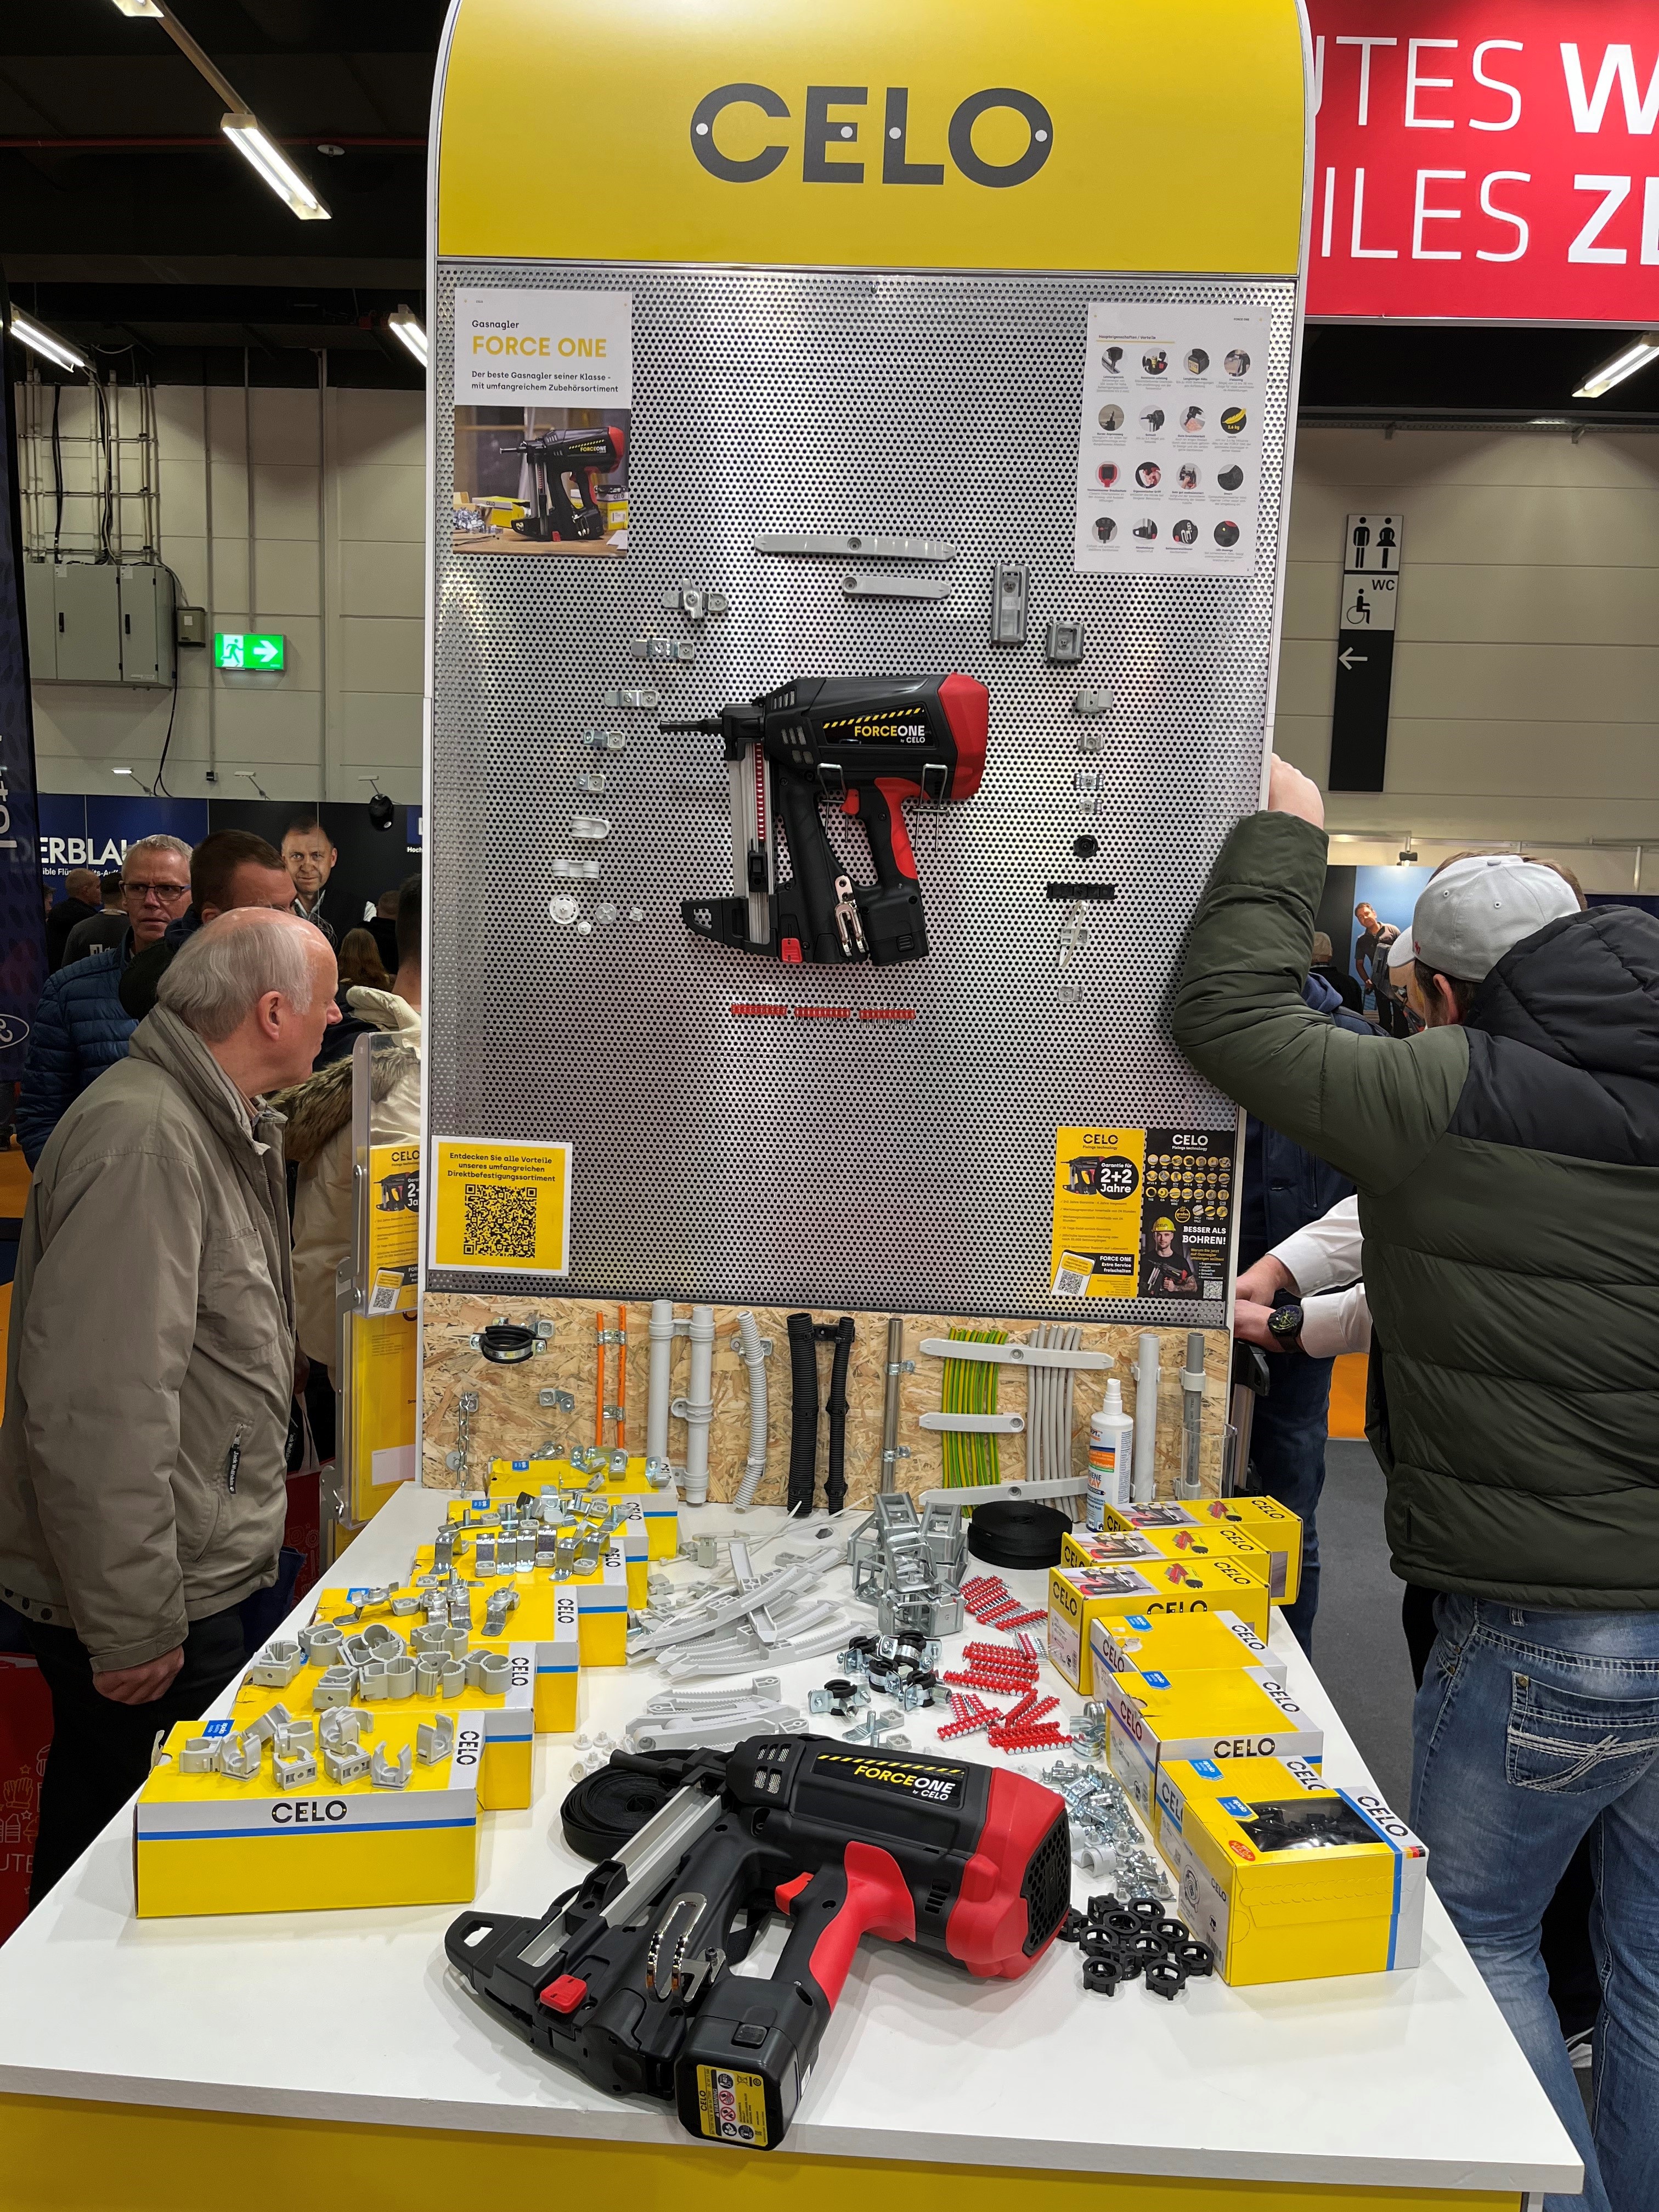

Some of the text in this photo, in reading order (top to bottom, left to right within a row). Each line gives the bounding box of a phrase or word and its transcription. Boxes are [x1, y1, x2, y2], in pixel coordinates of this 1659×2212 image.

[690, 83, 1053, 188] CELO
[472, 320, 520, 330] Gasnagler
[472, 336, 607, 357] FORCE ONE
[511, 372, 551, 380] Gasnagler
[486, 382, 547, 392] umfangreichem
[549, 383, 618, 392] Zubehörsortiment
[1372, 579, 1395, 591] WC
[855, 725, 925, 737] FORCEONE
[1083, 1134, 1119, 1144] CELO
[1172, 1134, 1209, 1146] CELO
[392, 1150, 420, 1162] CELO
[450, 1153, 488, 1161] Entdecken
[448, 1170, 555, 1182] Direktbefestigungssortiment
[489, 1164, 544, 1172] umfangreichen
[1101, 1168, 1132, 1183] 2+2
[1100, 1183, 1131, 1193] Jahre
[1182, 1235, 1226, 1245] BOHREN!
[1252, 1500, 1285, 1520] CELO
[1220, 1530, 1255, 1551] CELO
[1214, 1562, 1251, 1585] CELO
[1053, 1581, 1077, 1616] CELO
[557, 1599, 574, 1624] CELO
[1232, 1624, 1265, 1650] CELO
[1103, 1639, 1125, 1673] CELO
[511, 1657, 529, 1686] CELO
[1262, 1681, 1300, 1713] CELO
[1120, 1700, 1143, 1741] CELO
[456, 1731, 479, 1765] CELO
[1214, 1737, 1276, 1758] CELO
[854, 1765, 955, 1794] FORCEONE
[921, 1789, 949, 1801] CELO
[1161, 1782, 1183, 1822] CEL
[272, 1799, 347, 1823] CELO
[1357, 1796, 1408, 1837] CELO
[1211, 1877, 1227, 1903] CELO
